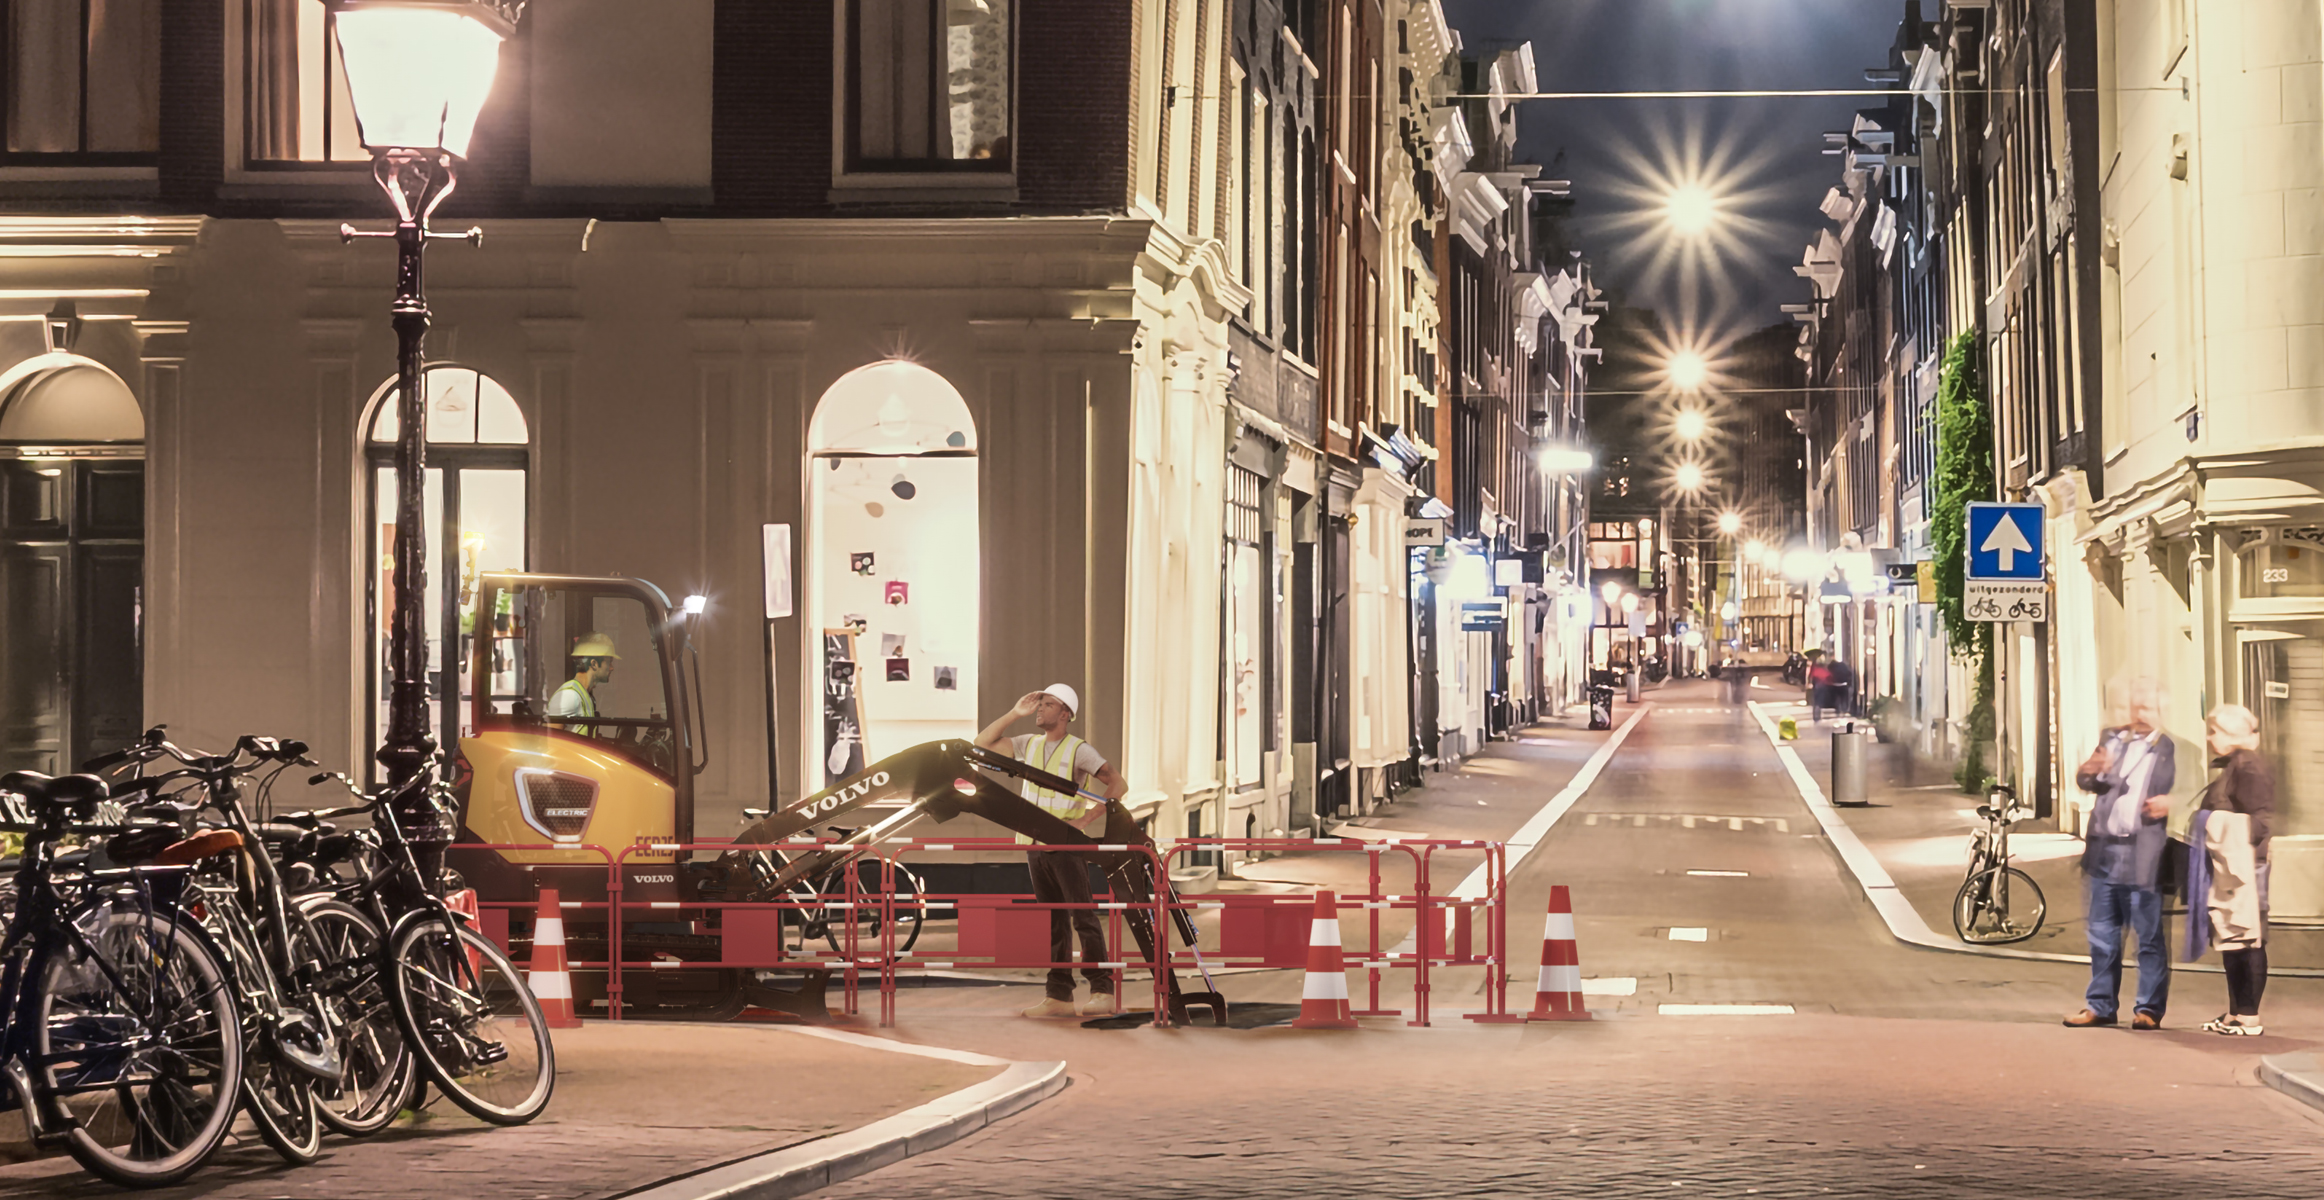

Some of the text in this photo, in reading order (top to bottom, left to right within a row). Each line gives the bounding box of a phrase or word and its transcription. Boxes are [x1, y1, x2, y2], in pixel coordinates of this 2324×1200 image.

[2263, 568, 2288, 583] 233
[1969, 585, 2044, 595] uitgezonderd
[796, 771, 890, 820] VOLVO
[635, 836, 673, 857] ECR25
[633, 874, 674, 883] VOLVO
